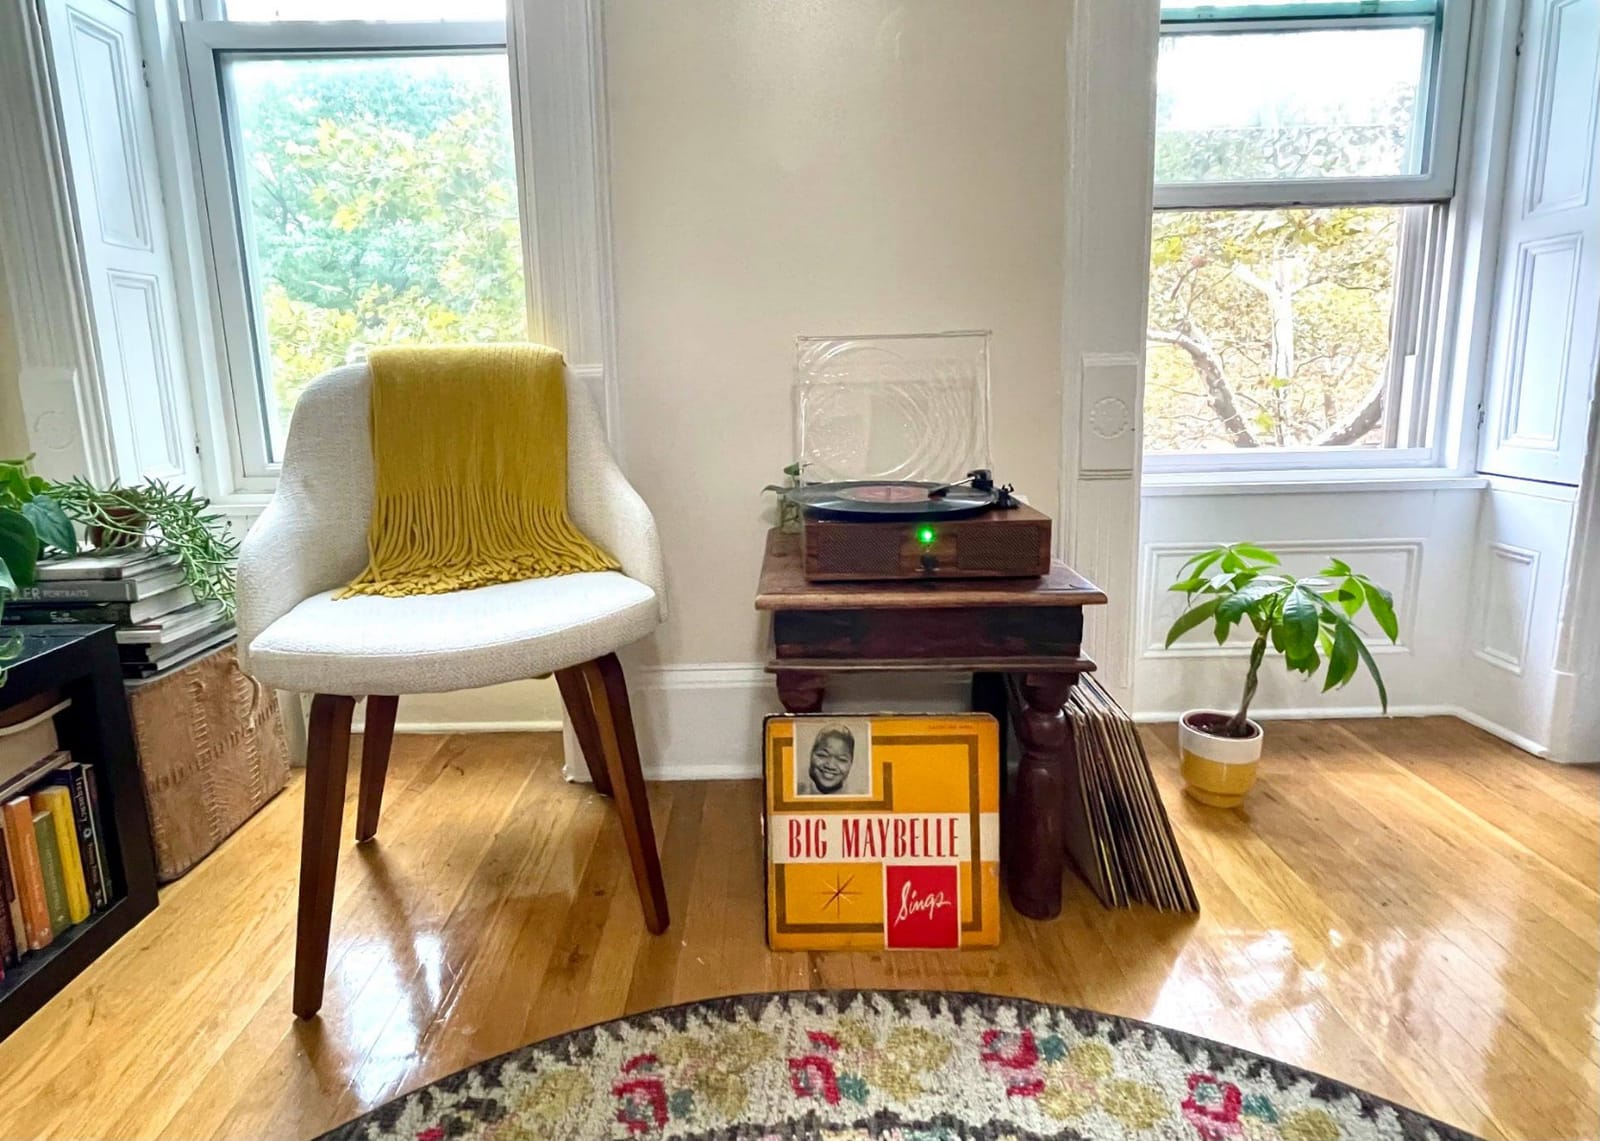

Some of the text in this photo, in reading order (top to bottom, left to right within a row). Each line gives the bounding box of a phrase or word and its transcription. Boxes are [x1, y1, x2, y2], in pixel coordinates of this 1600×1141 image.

[788, 818, 959, 858] BIG MAYBELLE
[894, 880, 951, 926] Sings
